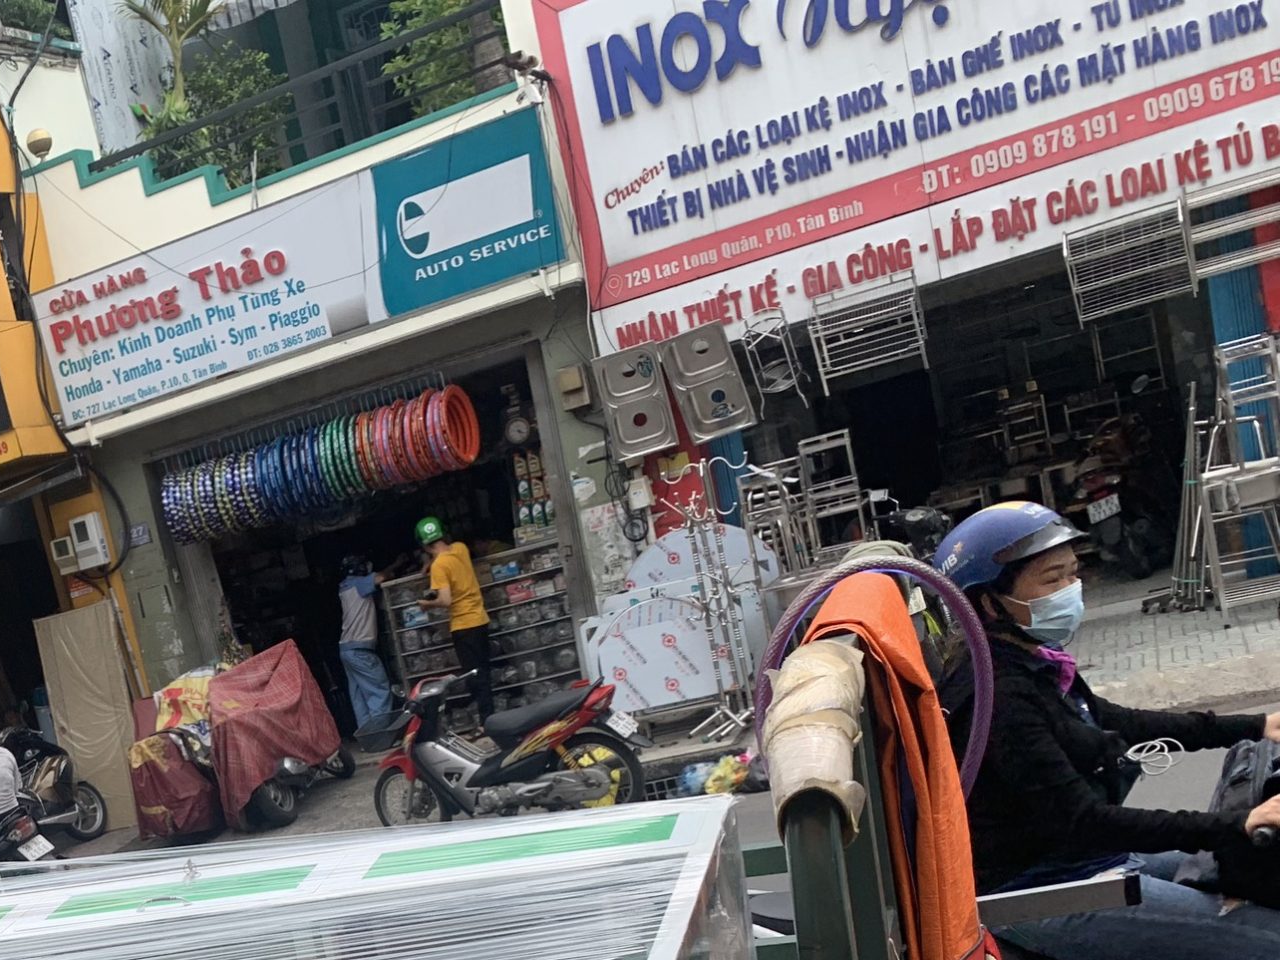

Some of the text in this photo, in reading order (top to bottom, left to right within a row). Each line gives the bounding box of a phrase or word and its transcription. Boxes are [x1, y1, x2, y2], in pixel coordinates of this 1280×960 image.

[586, 0, 762, 124] INOX
[604, 160, 665, 211] Chuyên:
[667, 144, 708, 180] BÁN
[711, 129, 751, 163] CÁC
[755, 112, 802, 149] LOẠI
[805, 96, 832, 131] KỆ
[836, 81, 888, 122] INOX
[911, 58, 956, 97] BÀN
[962, 31, 1004, 78] GHẾ
[1009, 18, 1064, 62] INOX
[628, 0, 1268, 236] THIẾT BỊ NHÀ VỆ SINH NHẬN GIA CÔNG CÁC MẶT HÀNG INOX
[624, 267, 651, 289] 729
[653, 260, 680, 280] Lạc
[683, 250, 718, 269] Long
[797, 211, 826, 234] Tân
[922, 165, 962, 194] ĐT:
[970, 140, 1027, 179] 0909
[1032, 127, 1077, 158] 878
[1080, 112, 1118, 144] 191
[1143, 83, 1205, 122] 0909
[1209, 66, 1256, 101] 678
[802, 261, 843, 299] GIA
[846, 238, 913, 284] CÔNG
[934, 208, 983, 260] LẮP
[992, 197, 1037, 242] ĐẶT
[1045, 179, 1098, 224] CÁC
[1174, 139, 1212, 186] KỆ
[1216, 121, 1253, 172] TỦ
[49, 267, 148, 315] CỬA HÀNG
[49, 247, 287, 354] Phương Thảo
[415, 224, 551, 281] AUTO SERVICE
[58, 277, 306, 378] Chuyên: Kinh Doanh Phụ Tùng Xe
[64, 301, 321, 402] Honda Yamaha Suzuki Sym Piaggio
[86, 404, 101, 416] 727
[102, 400, 117, 411] Lạc
[119, 394, 137, 407] Long
[193, 366, 209, 379] Tân
[247, 349, 261, 361] ĐT:
[263, 342, 280, 355] 028
[281, 336, 304, 350] 3865
[305, 326, 327, 342] 2003
[938, 553, 959, 576] VIB
